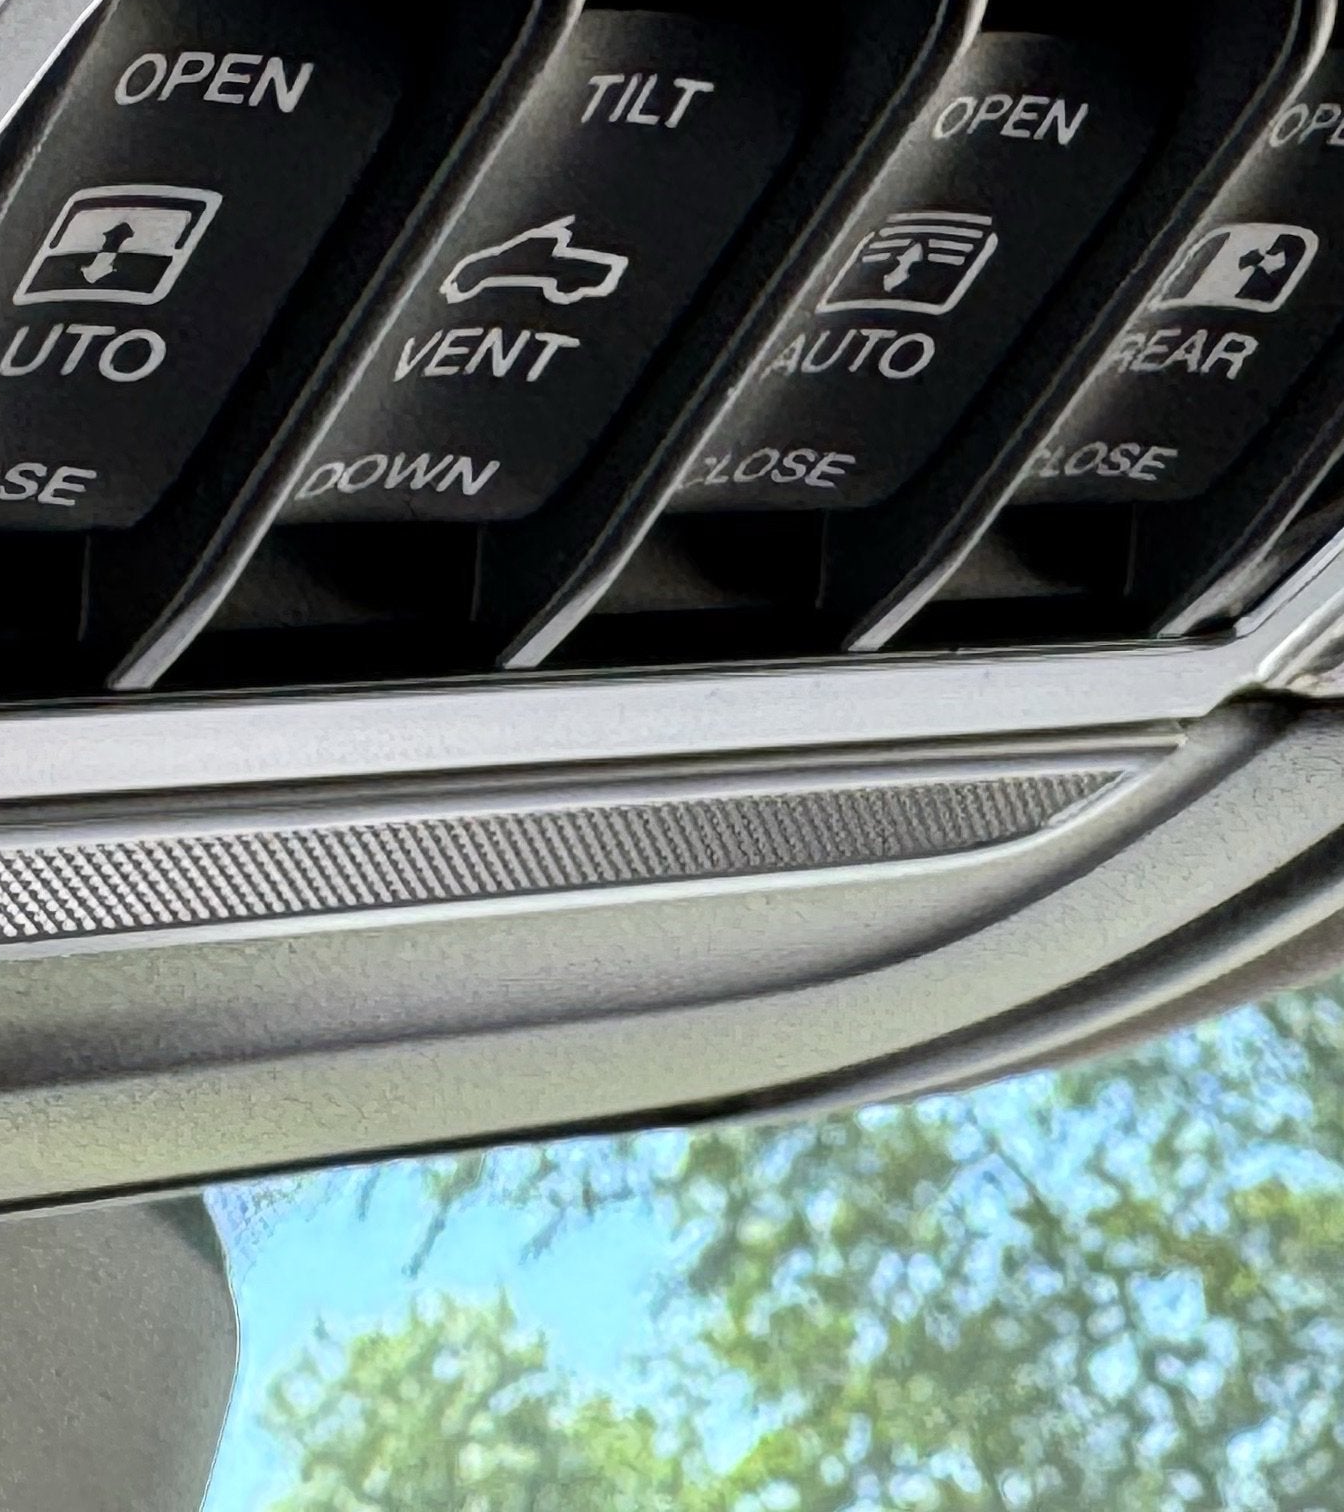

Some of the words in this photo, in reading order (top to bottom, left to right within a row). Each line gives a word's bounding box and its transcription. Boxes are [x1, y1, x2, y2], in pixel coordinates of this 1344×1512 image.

[114, 52, 314, 113] OPEN
[581, 74, 714, 129] TILT
[933, 95, 1088, 147] OPEN
[393, 328, 579, 385] VENT
[758, 329, 936, 380] AUTO
[1109, 328, 1260, 380] REAR
[294, 453, 500, 500] DOWN
